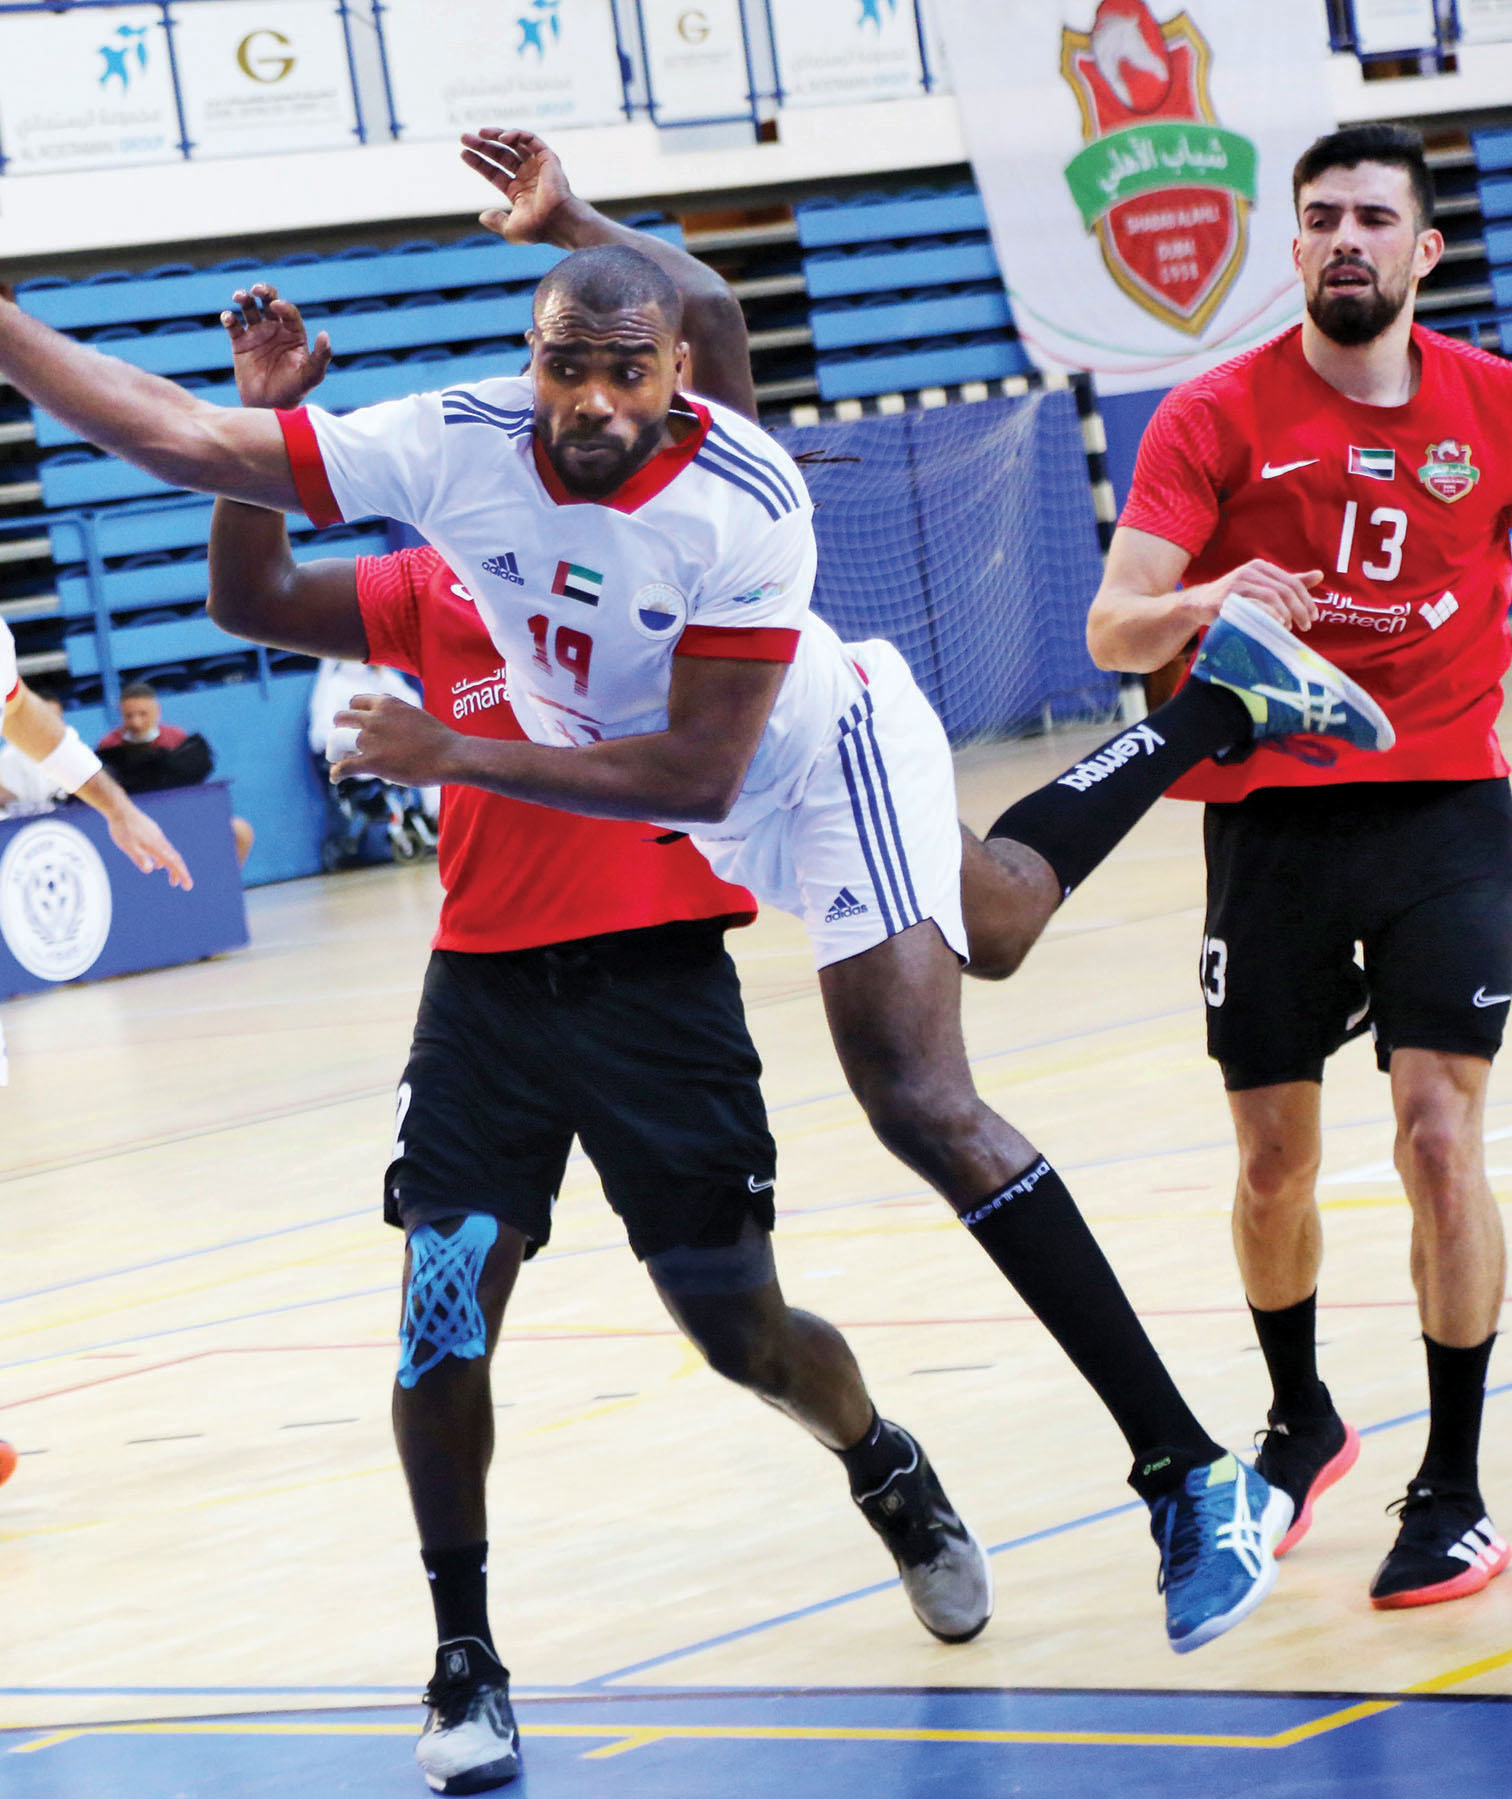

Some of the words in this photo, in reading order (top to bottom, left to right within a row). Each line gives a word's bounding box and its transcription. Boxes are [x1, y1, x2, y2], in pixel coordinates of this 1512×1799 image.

[237, 29, 296, 83] G
[1337, 500, 1408, 582] 13
[481, 561, 525, 586] adidas
[1319, 609, 1407, 633] ratech
[527, 613, 594, 698] 19
[1057, 723, 1166, 792] Kempa
[825, 904, 869, 924] adidas
